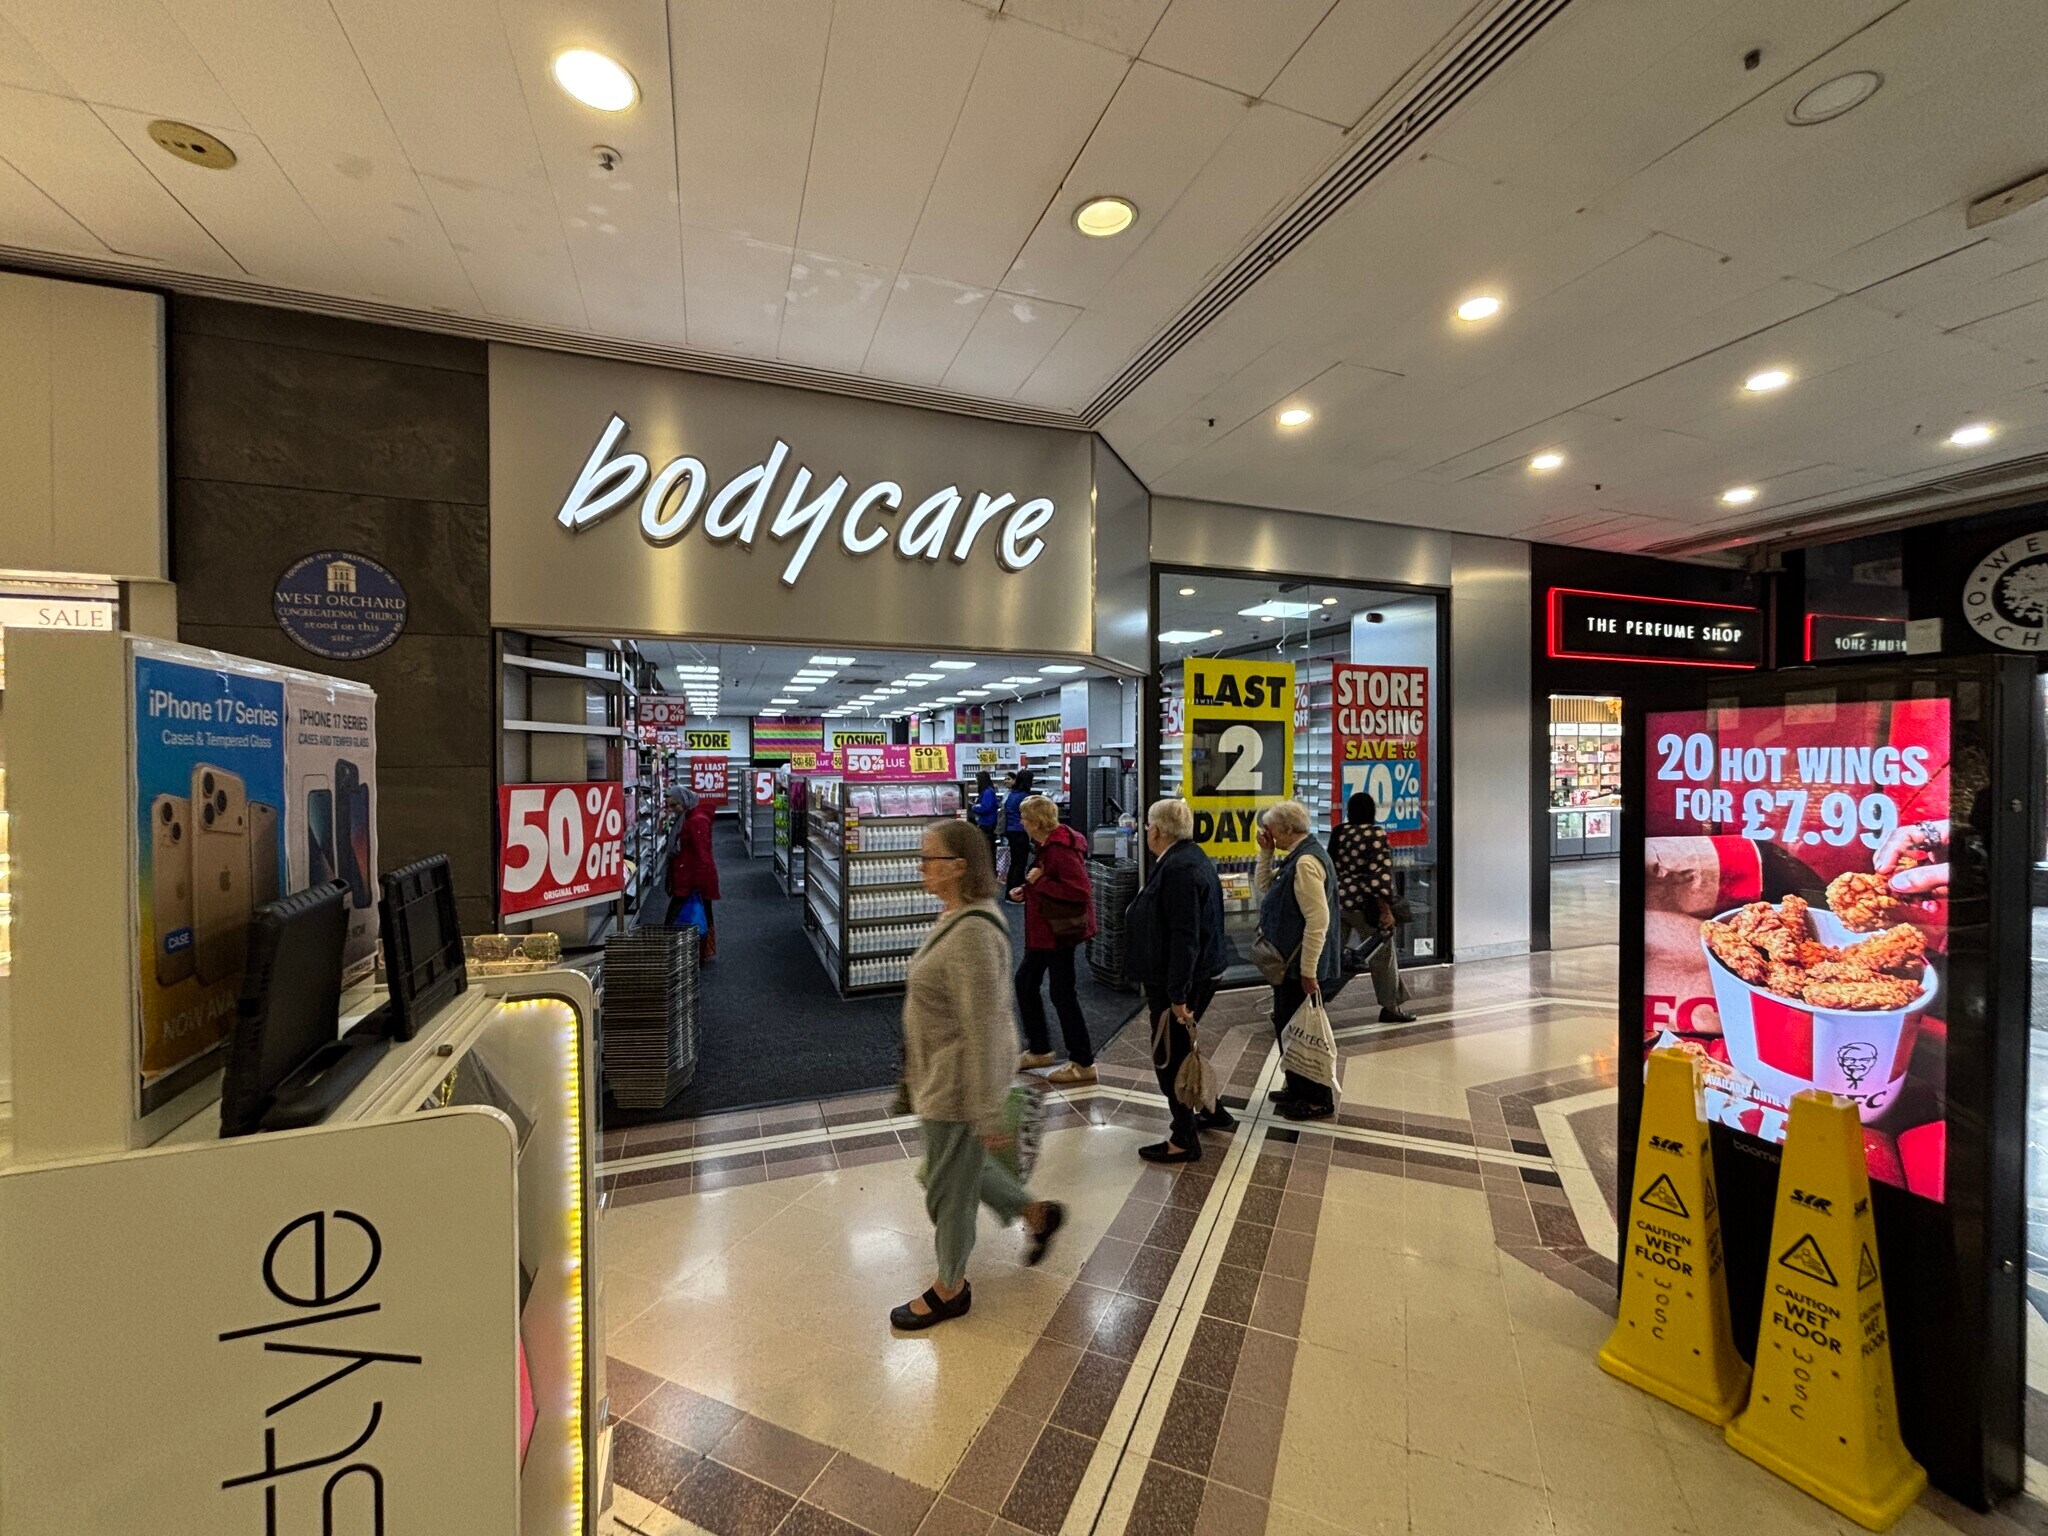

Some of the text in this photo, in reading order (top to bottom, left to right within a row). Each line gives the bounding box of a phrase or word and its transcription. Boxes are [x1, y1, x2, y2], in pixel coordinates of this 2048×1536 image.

[554, 411, 1056, 587] bodycare
[275, 592, 406, 609] WEST ORCHARD
[39, 608, 104, 627] SALE
[278, 607, 403, 621] CONGREGATIONAL CHURCH
[304, 621, 380, 632] stood on this
[1588, 617, 1742, 643] THE PERFUME SHOP
[330, 634, 354, 642] site
[1194, 673, 1286, 708] LAST
[1337, 670, 1424, 707] STORE
[149, 689, 278, 727] iPhone 17 Series
[641, 704, 684, 722] 50%
[669, 712, 685, 722] OFF
[333, 714, 341, 729] 17
[342, 714, 368, 732] SERIES
[1337, 709, 1424, 736] CLOSING
[162, 729, 272, 750] Cases & Tempered Glass
[298, 732, 370, 748] CASES AND TEMPER GLASS
[688, 733, 728, 747] STORE
[834, 734, 885, 748] CLOSING!
[1016, 723, 1033, 742] STORE
[1065, 742, 1086, 753] AT LEAST
[1346, 741, 1416, 759] SAVE UP
[1403, 751, 1416, 759] TO
[848, 755, 885, 771] 50%
[872, 763, 885, 771] OFF
[886, 758, 906, 768] LUE
[1215, 725, 1263, 790] 2
[1657, 733, 1929, 786] 20 HOT WINGS
[695, 772, 724, 789] 50%
[1395, 797, 1419, 820] OFF
[1194, 810, 1266, 844] DAY
[1676, 788, 1897, 850] FOR £7.99
[503, 786, 621, 893] 50%
[586, 840, 621, 880] OFF
[543, 883, 590, 900] ORIGINAL PRICE
[168, 932, 190, 949] CASE
[1637, 1220, 1691, 1246] CAUTION
[1645, 1234, 1682, 1257] WET
[1635, 1245, 1693, 1277] FLOOR
[1776, 1284, 1841, 1320] CAUTION
[1785, 1300, 1830, 1330] WET
[1773, 1312, 1842, 1355] FLOOR
